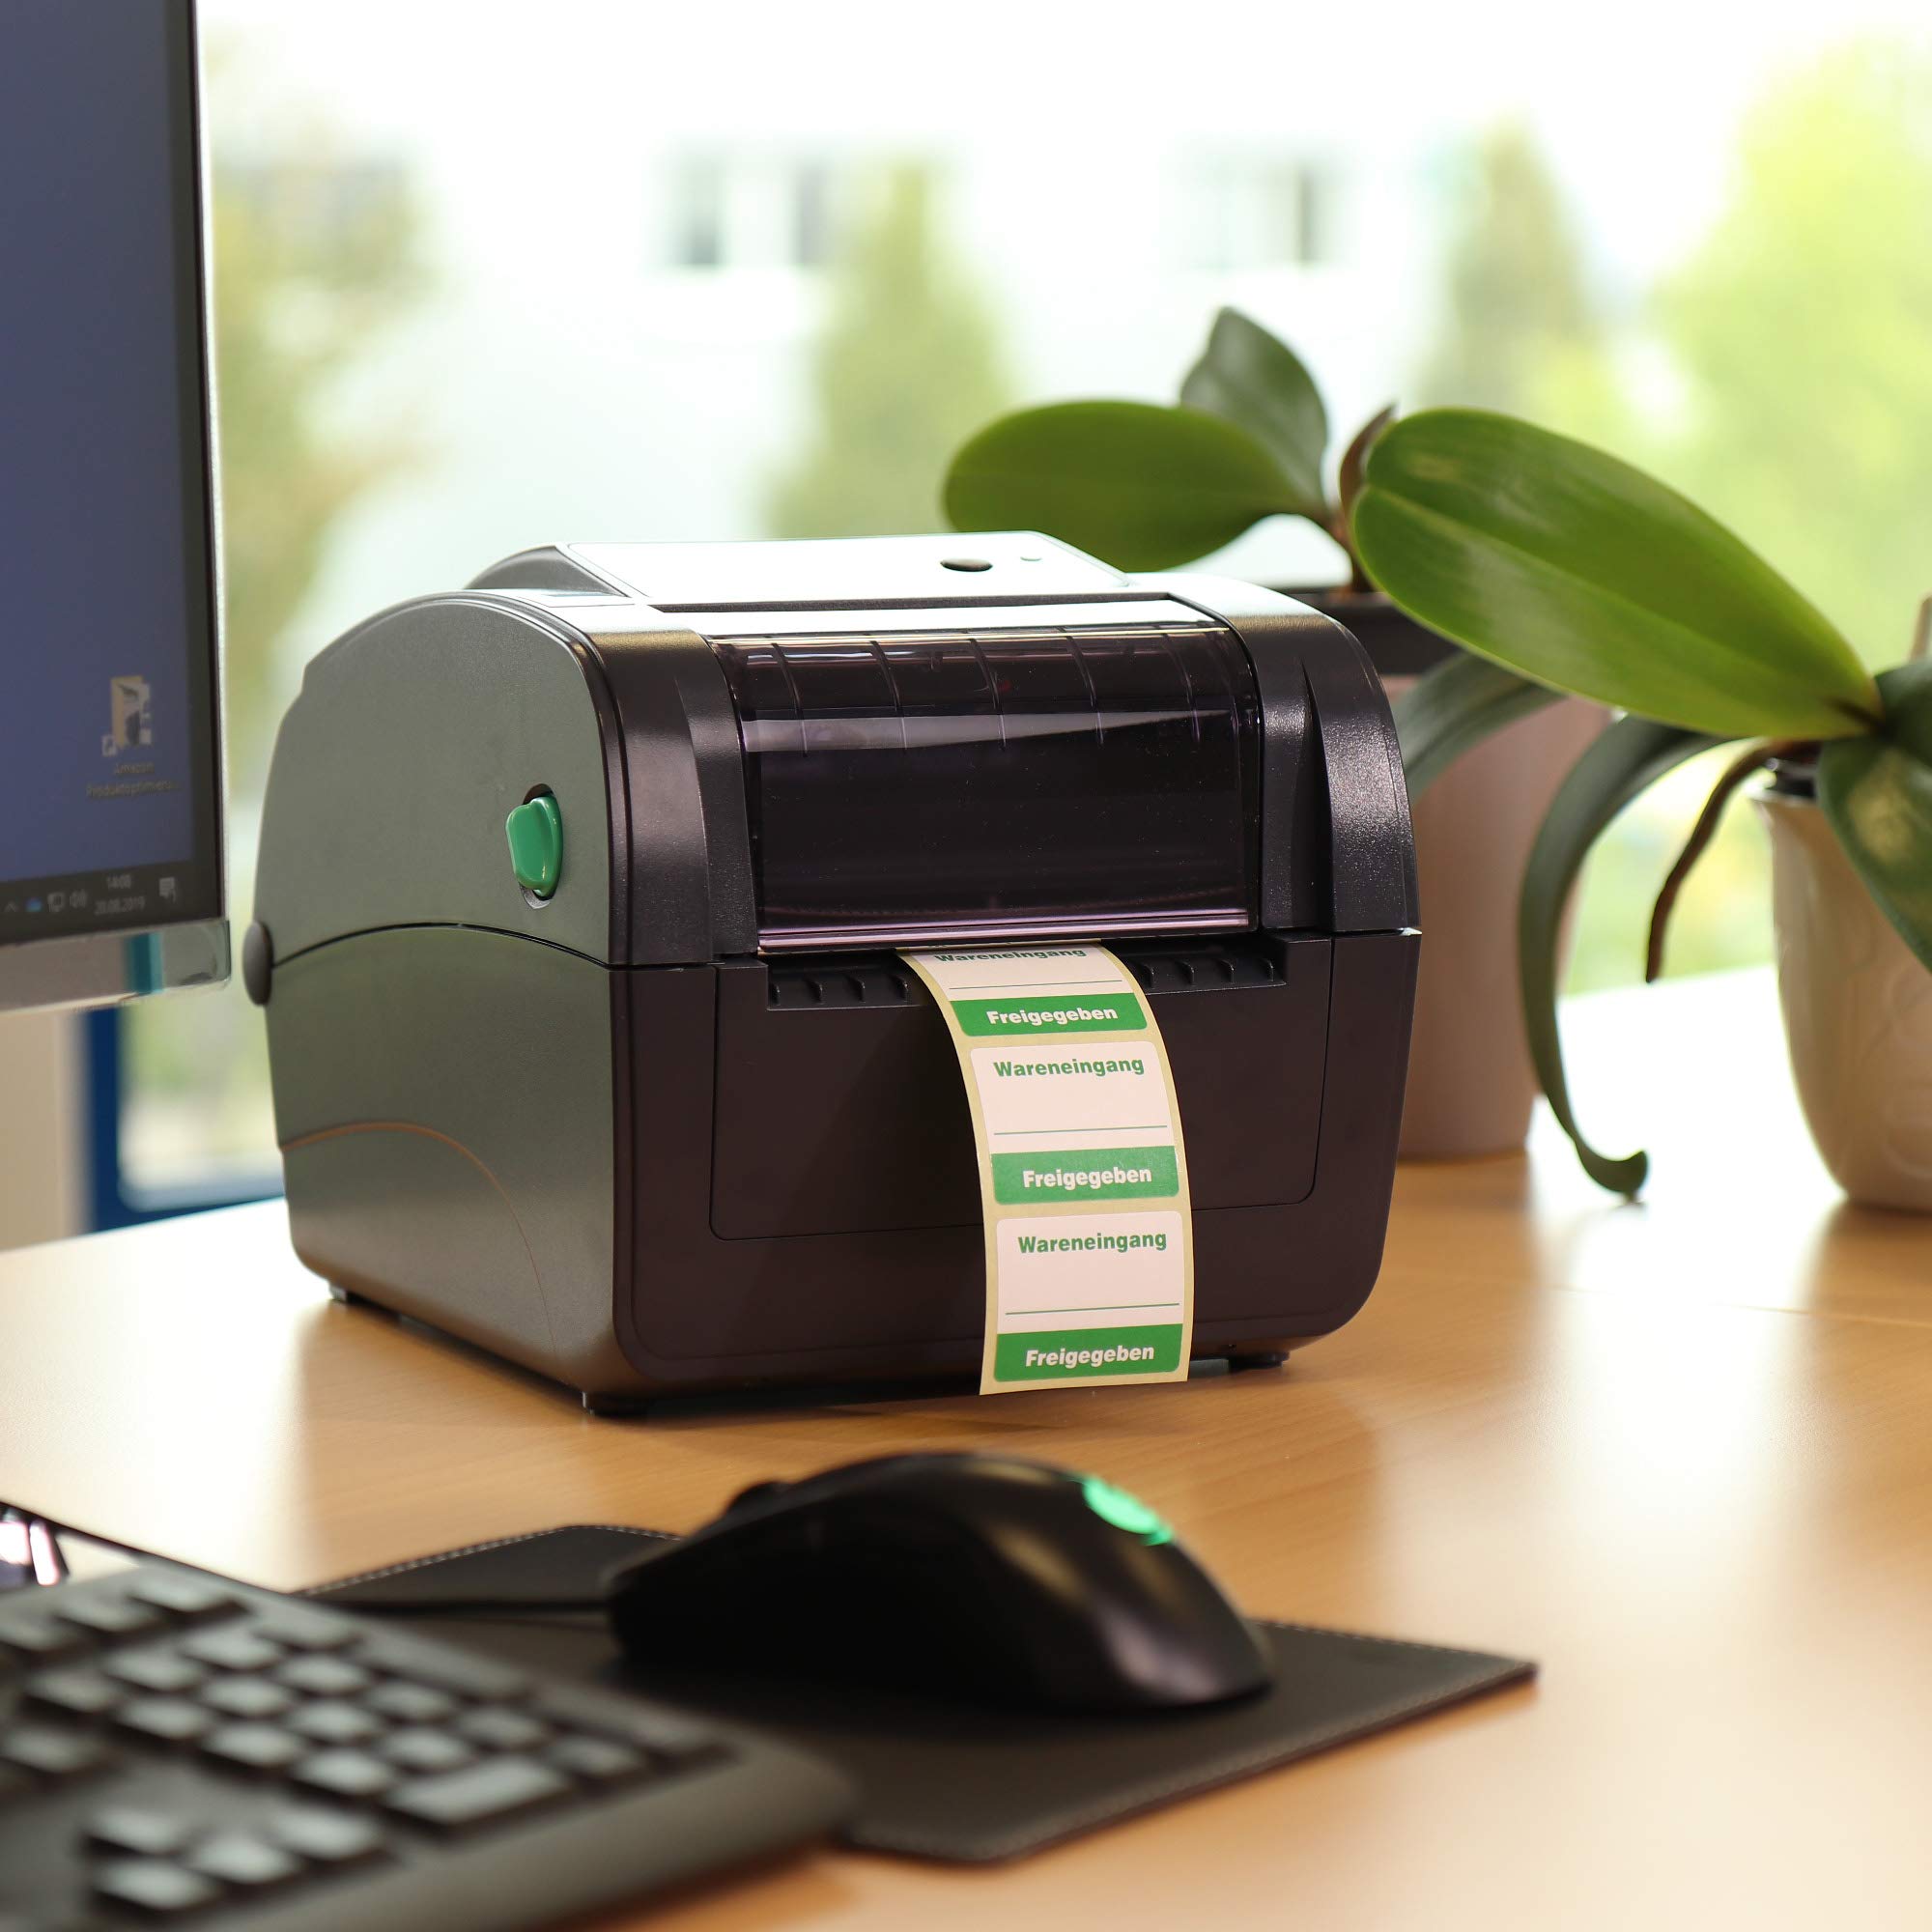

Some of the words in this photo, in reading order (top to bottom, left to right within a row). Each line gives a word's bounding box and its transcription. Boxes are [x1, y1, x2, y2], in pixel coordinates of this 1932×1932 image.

[935, 948, 1088, 961] Wareneingang
[986, 1008, 1119, 1026] Freigegeben
[993, 1058, 1145, 1077] Wareneingang
[1022, 1166, 1152, 1190] Freigegeben
[1017, 1233, 1167, 1254] Wareneingang
[1025, 1345, 1154, 1368] Freigegeben
